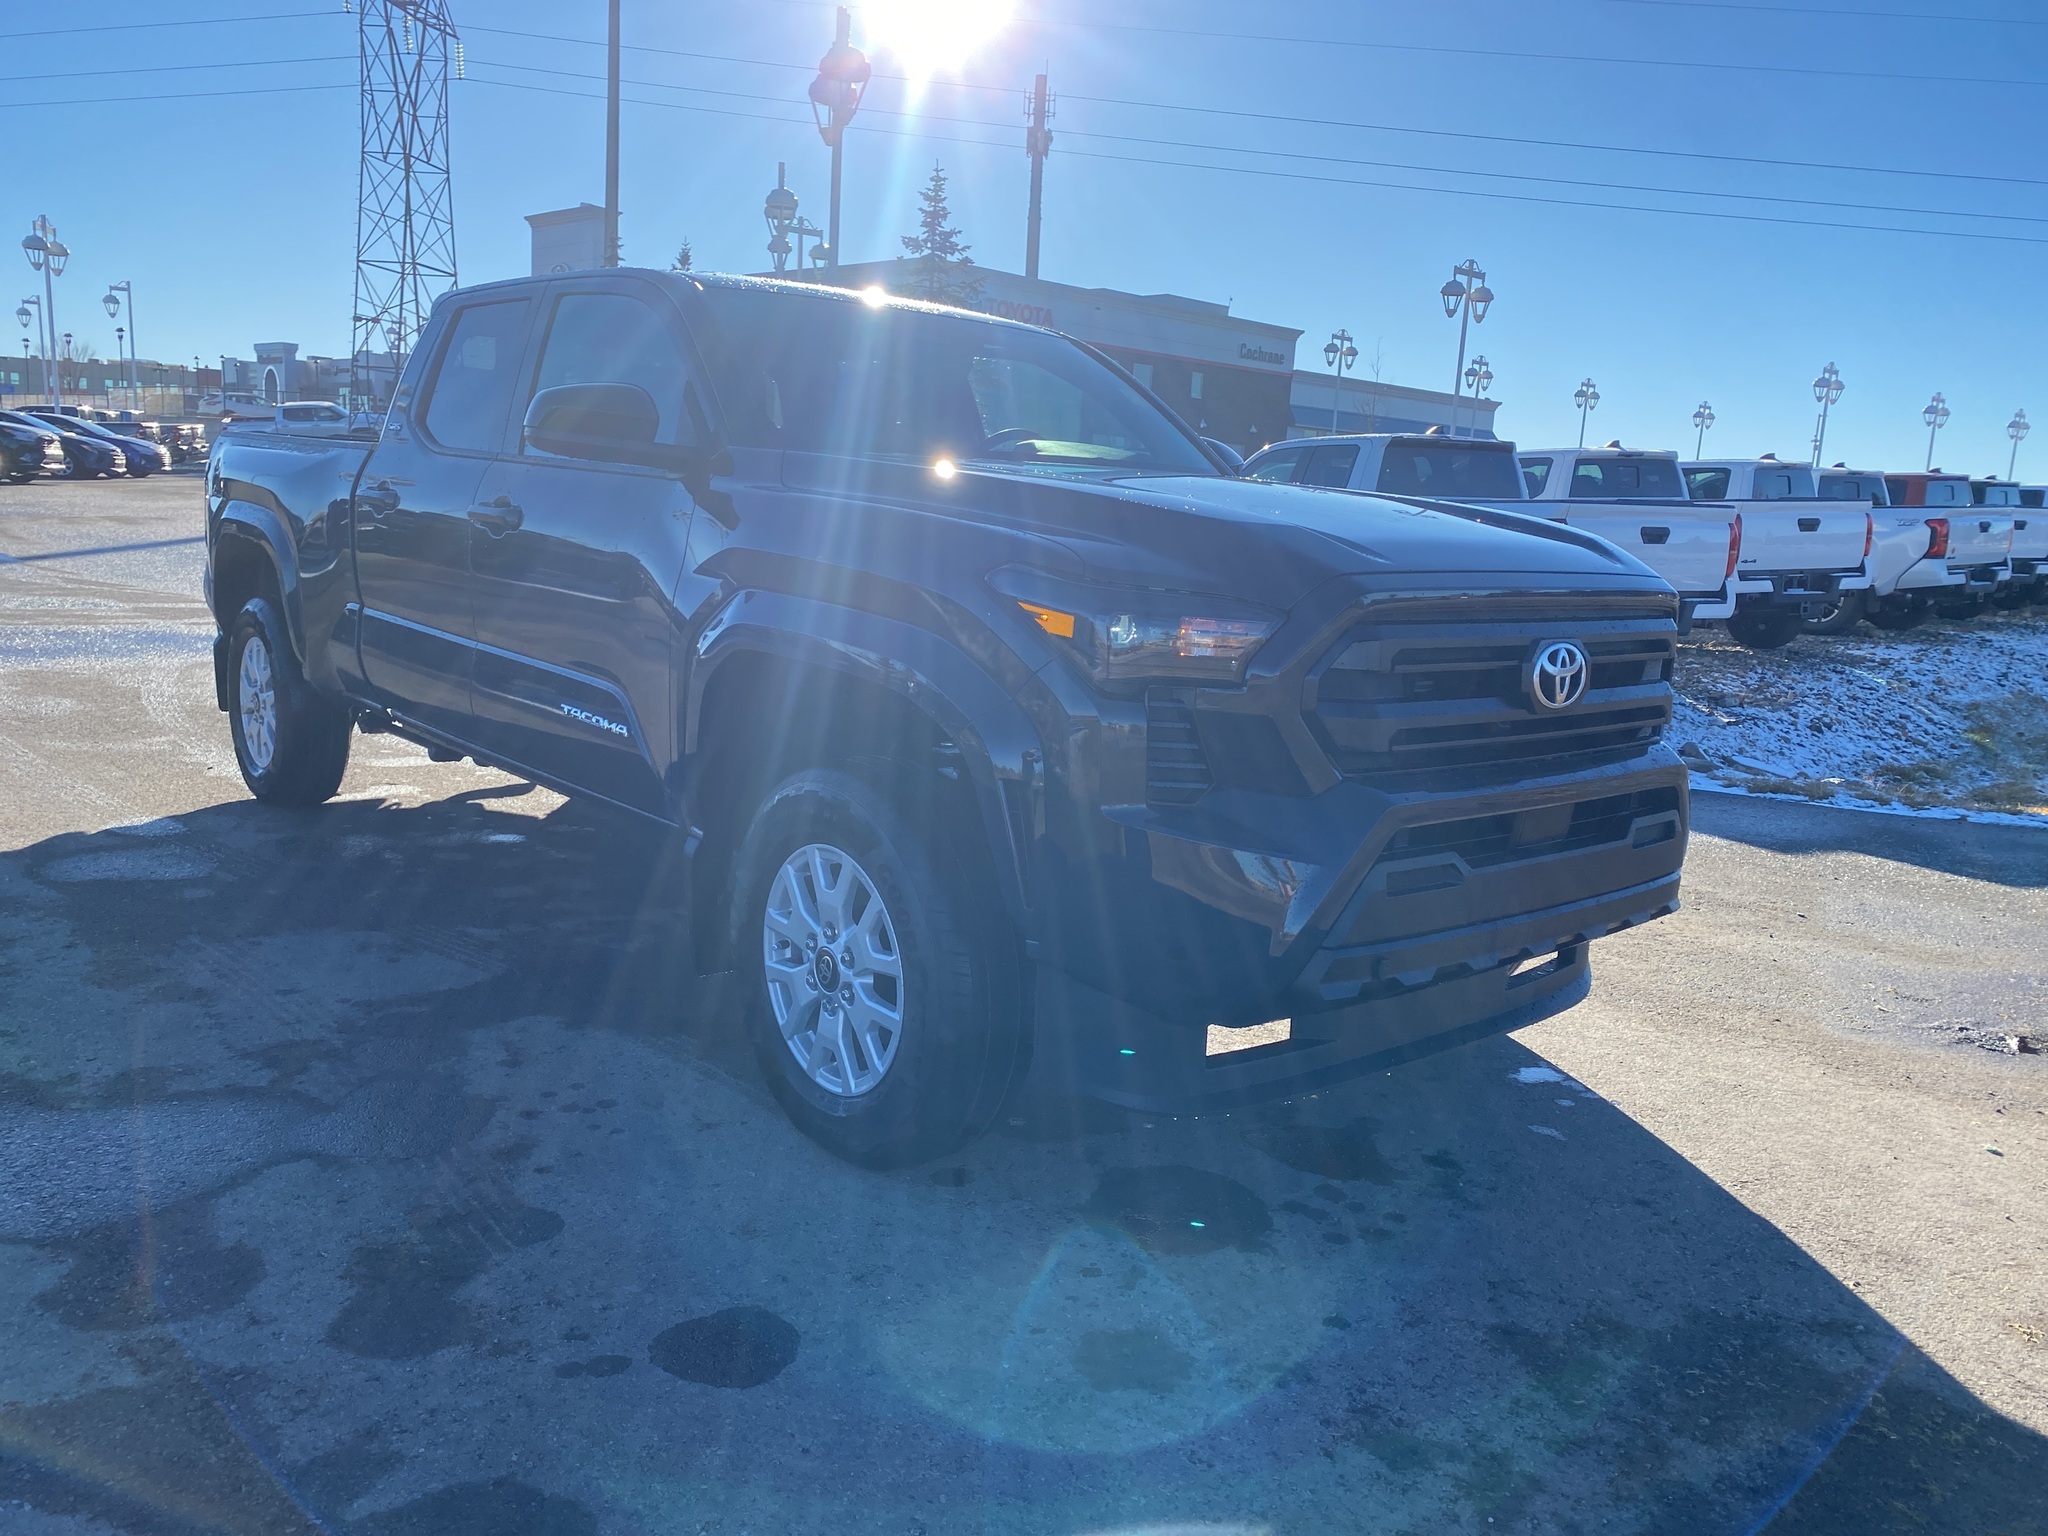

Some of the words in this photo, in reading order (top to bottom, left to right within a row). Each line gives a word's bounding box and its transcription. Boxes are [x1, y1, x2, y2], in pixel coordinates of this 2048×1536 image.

[986, 297, 1054, 327] TOYOTA
[1239, 343, 1285, 365] Cochrane
[560, 703, 629, 738] TACOMA
